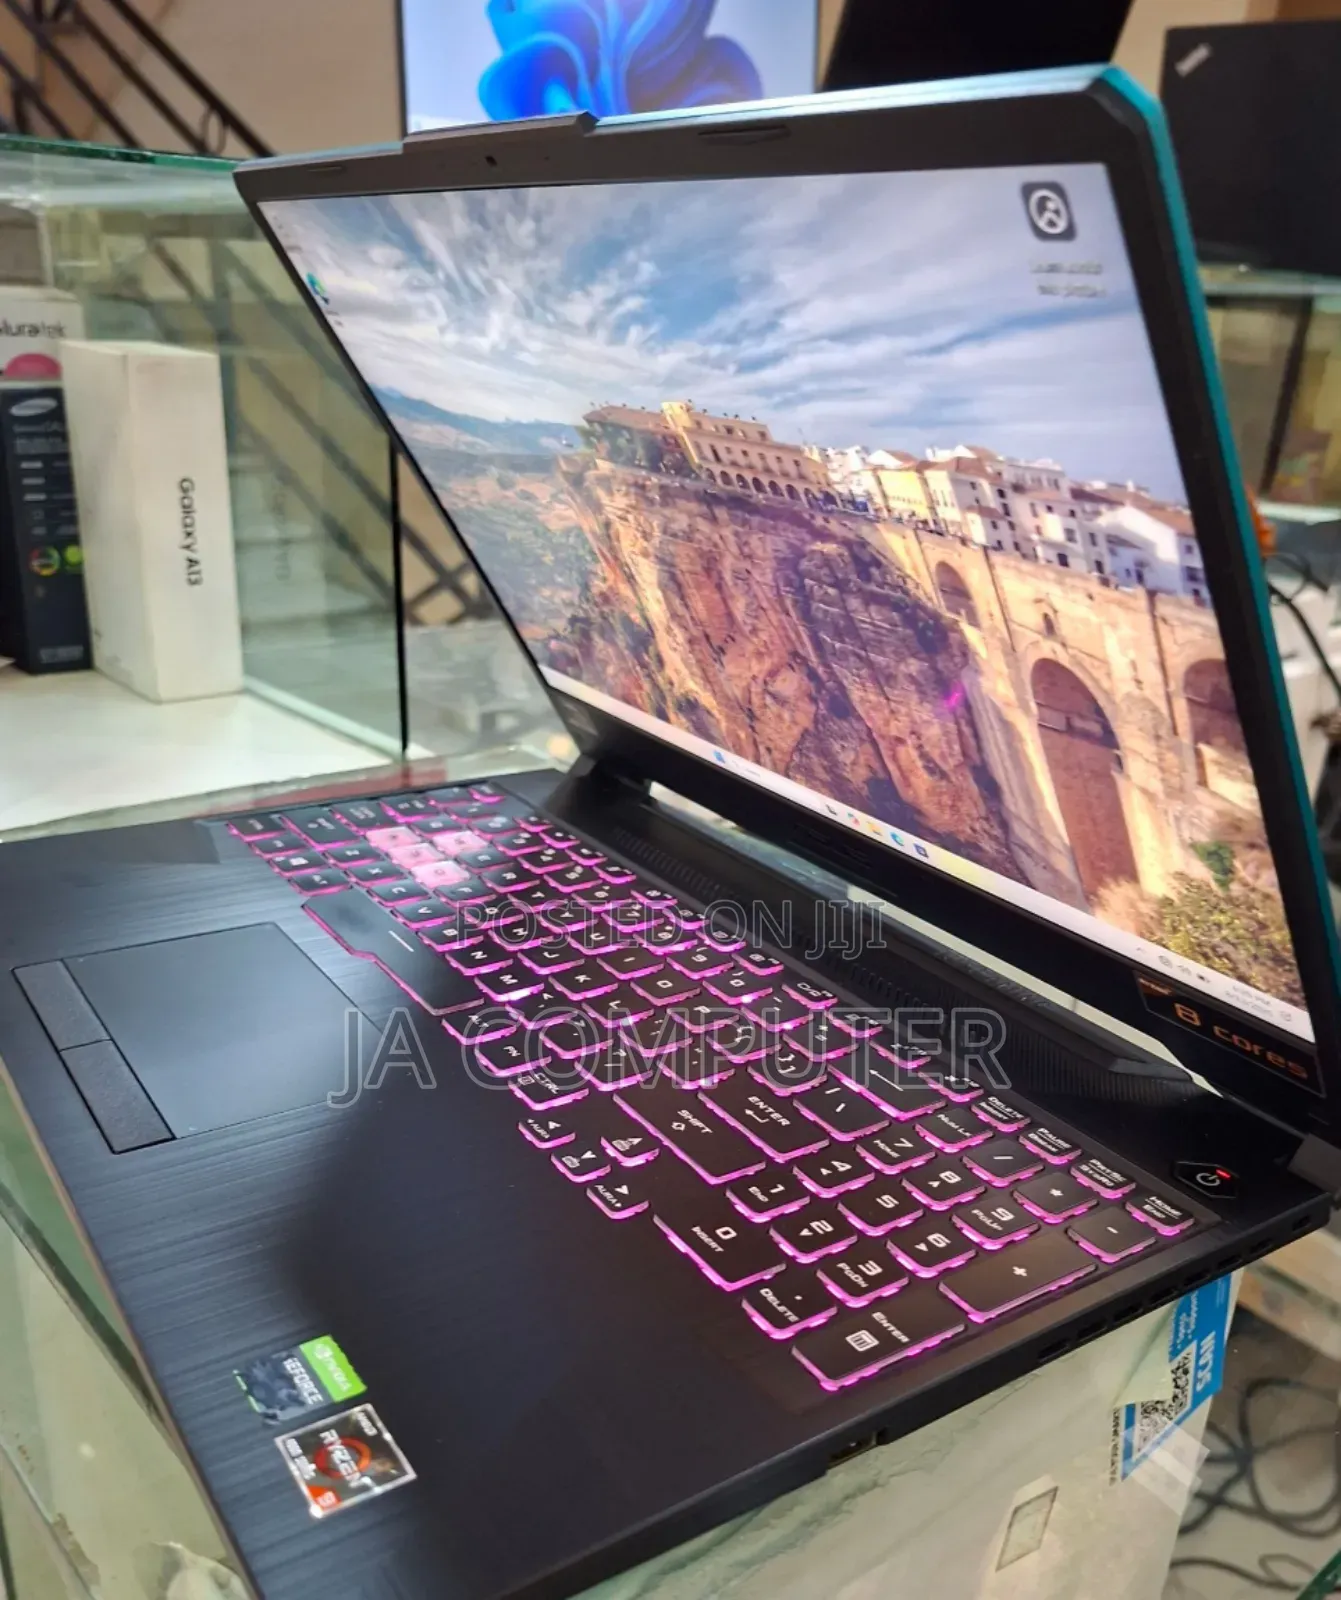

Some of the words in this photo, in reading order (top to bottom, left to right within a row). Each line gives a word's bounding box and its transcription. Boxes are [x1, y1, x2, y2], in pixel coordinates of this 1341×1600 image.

[178, 477, 198, 554] Galaxy
[186, 556, 204, 587] A13
[471, 950, 487, 960] N
[542, 951, 560, 960] J
[499, 974, 518, 985] M
[574, 974, 592, 984] K
[608, 999, 621, 1010] L
[693, 1005, 711, 1014] P
[1213, 1025, 1309, 1080] cores
[747, 1095, 791, 1127] ENTER
[677, 1109, 713, 1134] SHIFT
[893, 1137, 914, 1148] 7
[830, 1160, 852, 1172] 4
[938, 1170, 962, 1184] 8
[769, 1184, 785, 1193] 1
[875, 1194, 900, 1209] 5
[991, 1207, 1016, 1221] 9
[809, 1219, 835, 1235] 2
[926, 1232, 952, 1248] 6
[857, 1259, 884, 1277] 3
[759, 1287, 800, 1323] DELETE
[319, 1428, 365, 1488] RYZEN
